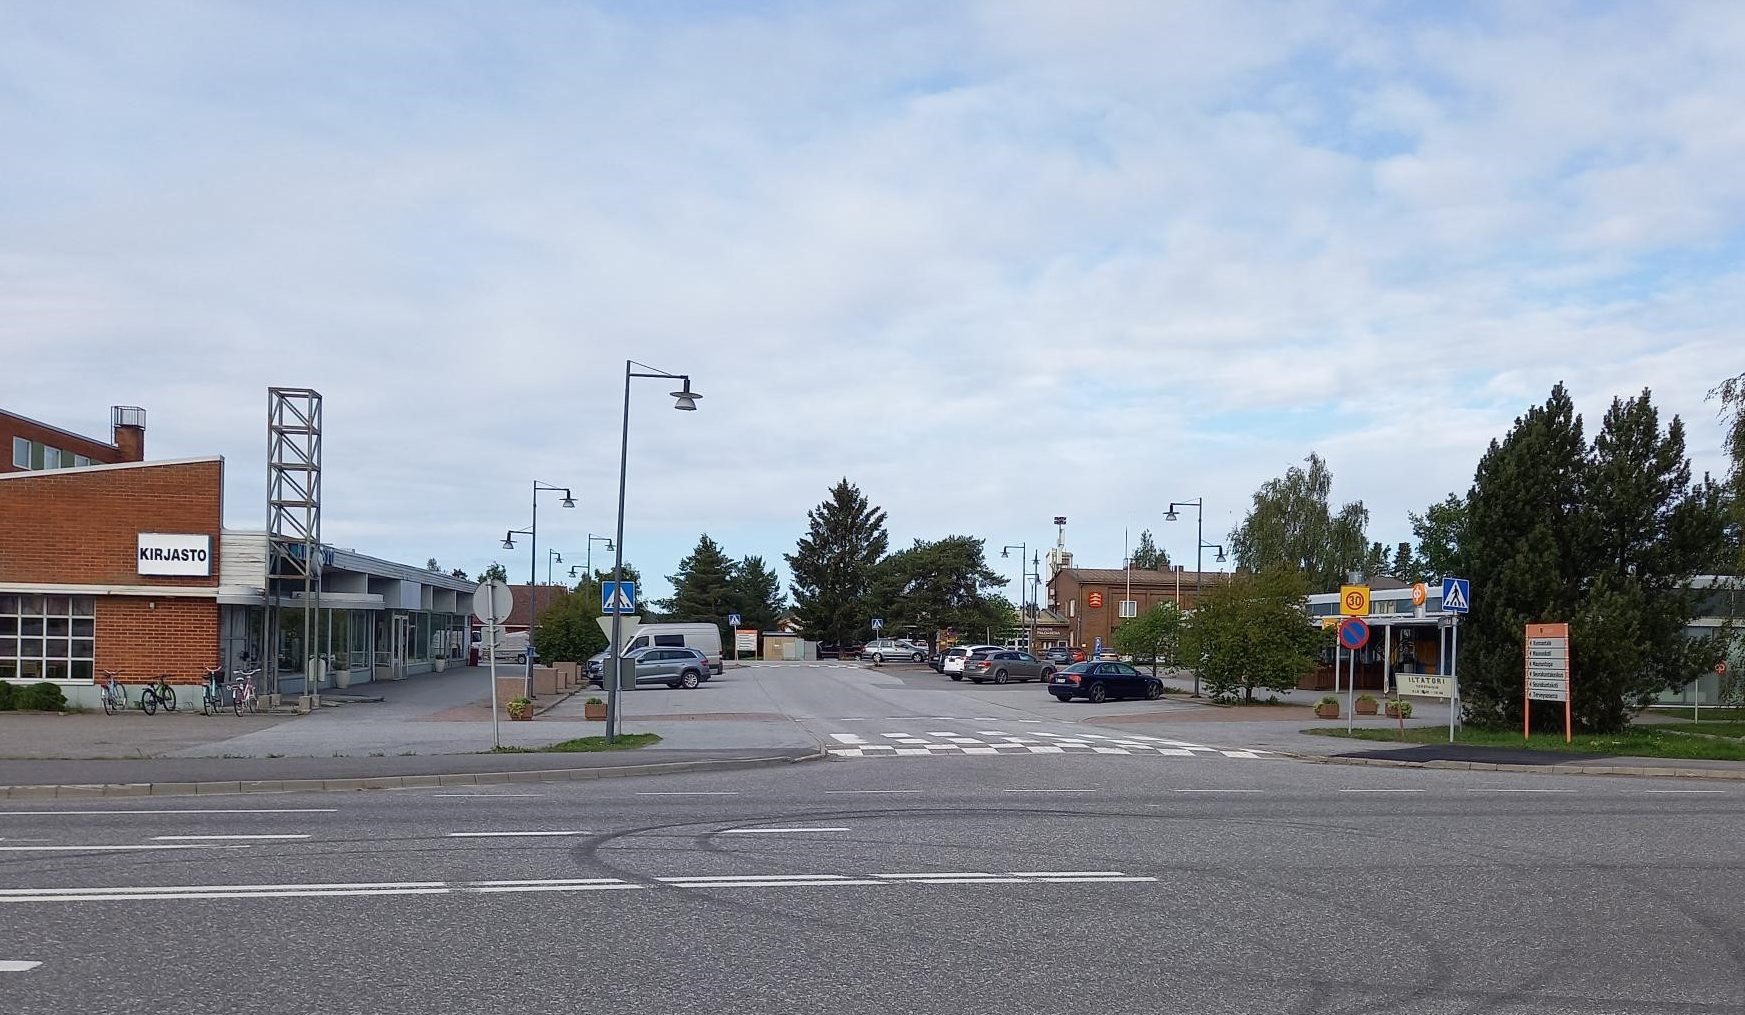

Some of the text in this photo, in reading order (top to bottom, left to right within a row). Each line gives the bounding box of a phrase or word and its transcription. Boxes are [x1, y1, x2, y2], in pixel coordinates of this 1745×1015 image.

[140, 547, 207, 562] KIRJASTO
[1349, 595, 1361, 606] 30
[1408, 676, 1445, 684] ILTATORI
